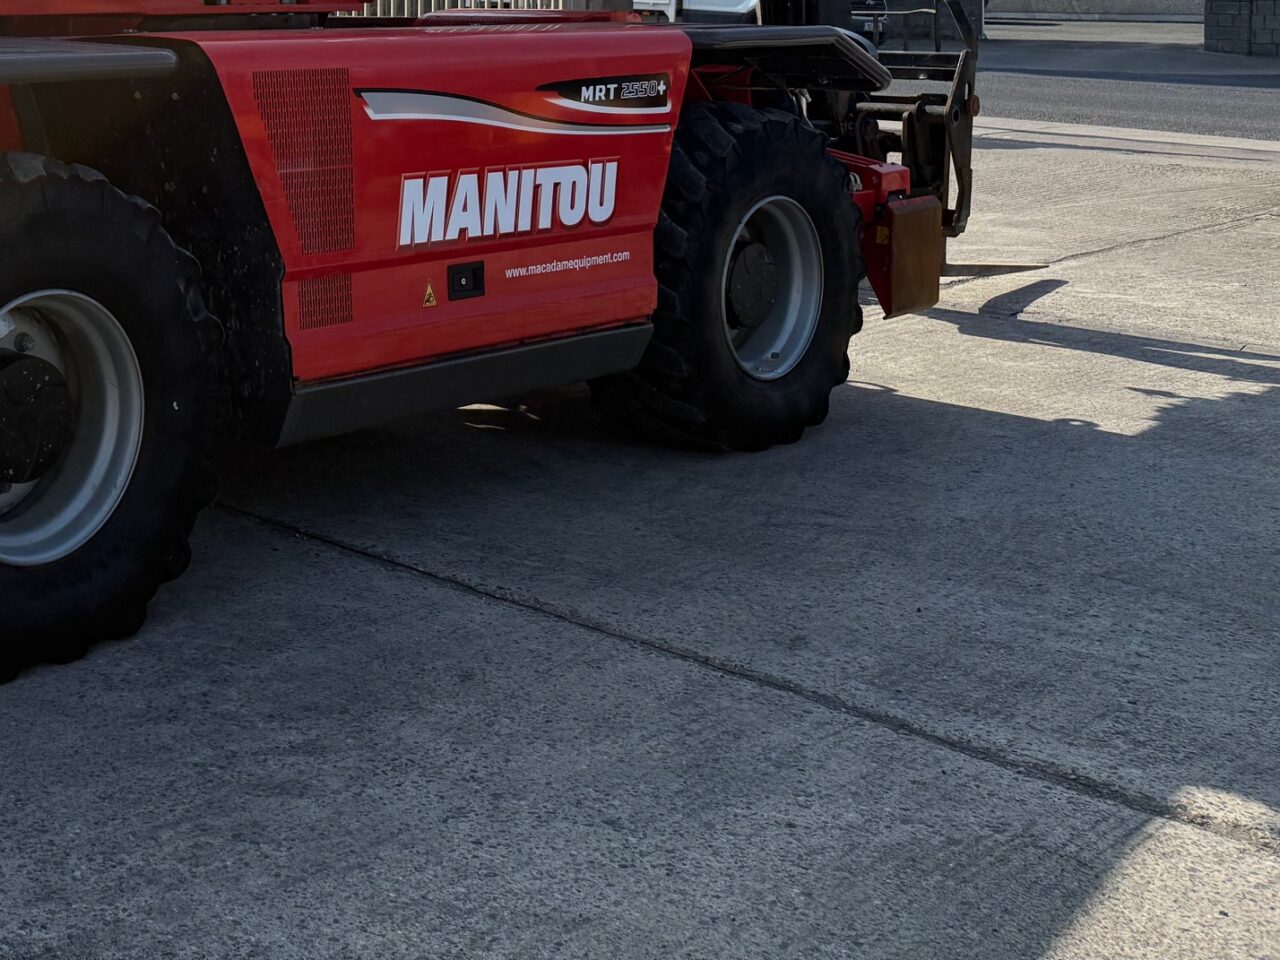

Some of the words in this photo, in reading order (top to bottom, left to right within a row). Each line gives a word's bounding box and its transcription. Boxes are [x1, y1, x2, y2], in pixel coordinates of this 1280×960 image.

[580, 83, 618, 103] MRT
[398, 161, 619, 246] MANITOU
[505, 249, 630, 279] www.macadamequipment.com
